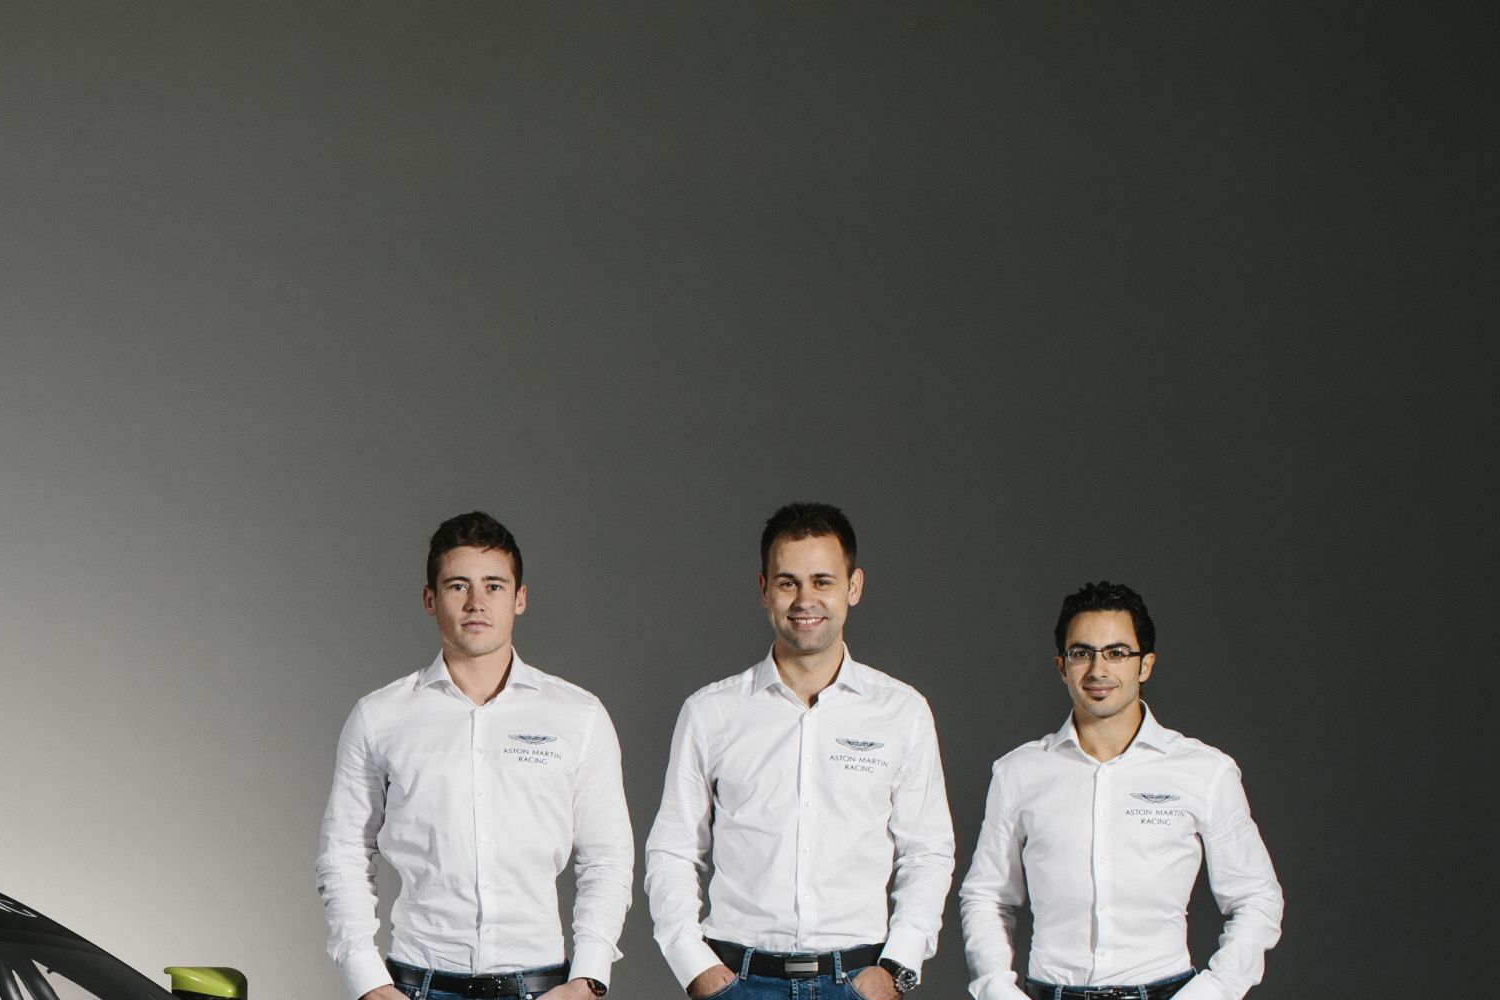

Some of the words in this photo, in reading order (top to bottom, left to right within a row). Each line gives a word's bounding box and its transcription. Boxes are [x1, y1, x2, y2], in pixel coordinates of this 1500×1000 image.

[532, 750, 562, 760] MARTIN
[518, 757, 548, 765] RACING
[830, 754, 856, 762] ASTON
[859, 757, 889, 768] MARTIN
[844, 764, 874, 774] RACING
[1125, 809, 1152, 817] ASTON
[1156, 809, 1186, 818] MARTIN
